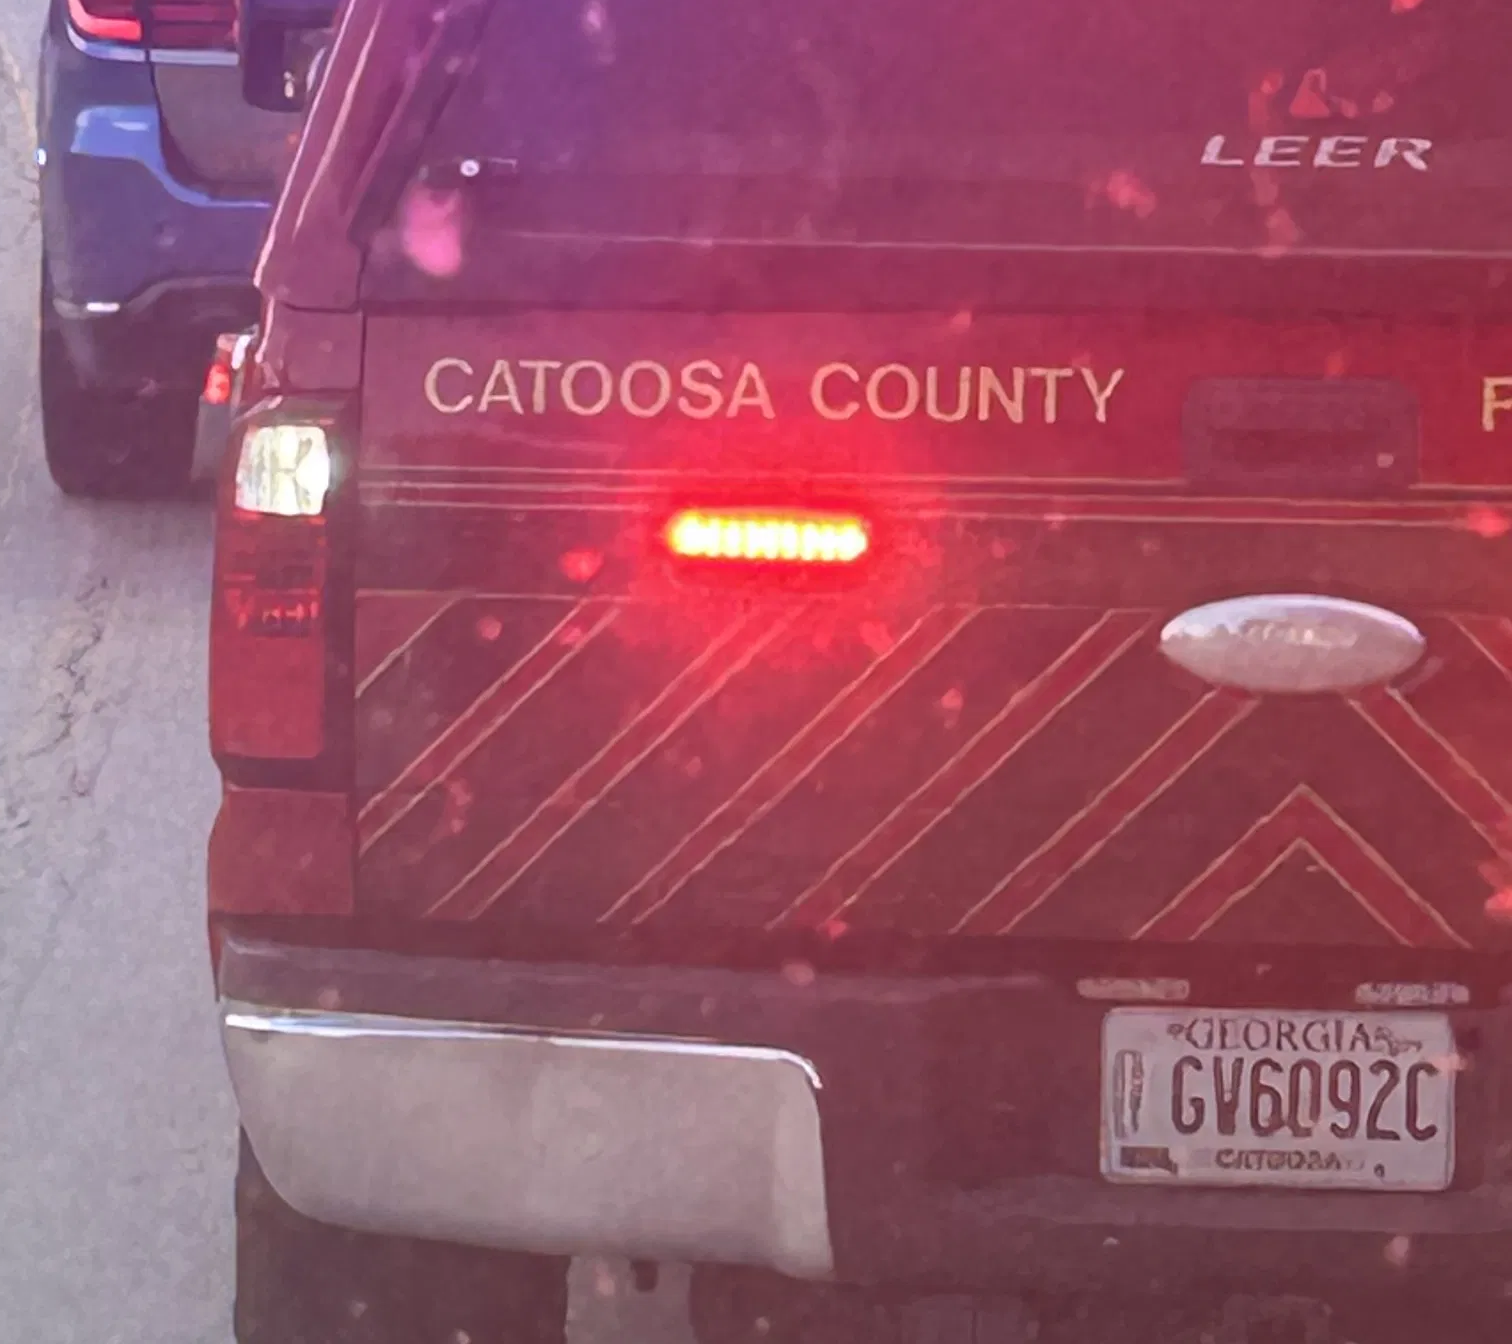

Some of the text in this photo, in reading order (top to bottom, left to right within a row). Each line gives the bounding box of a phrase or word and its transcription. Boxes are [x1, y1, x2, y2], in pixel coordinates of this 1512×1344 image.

[1200, 135, 1434, 171] LEER
[424, 357, 777, 419] CATOOSA
[810, 361, 1126, 424] COUNTY
[1186, 1018, 1372, 1053] GEORGIA
[1170, 1055, 1440, 1142] GV6092C
